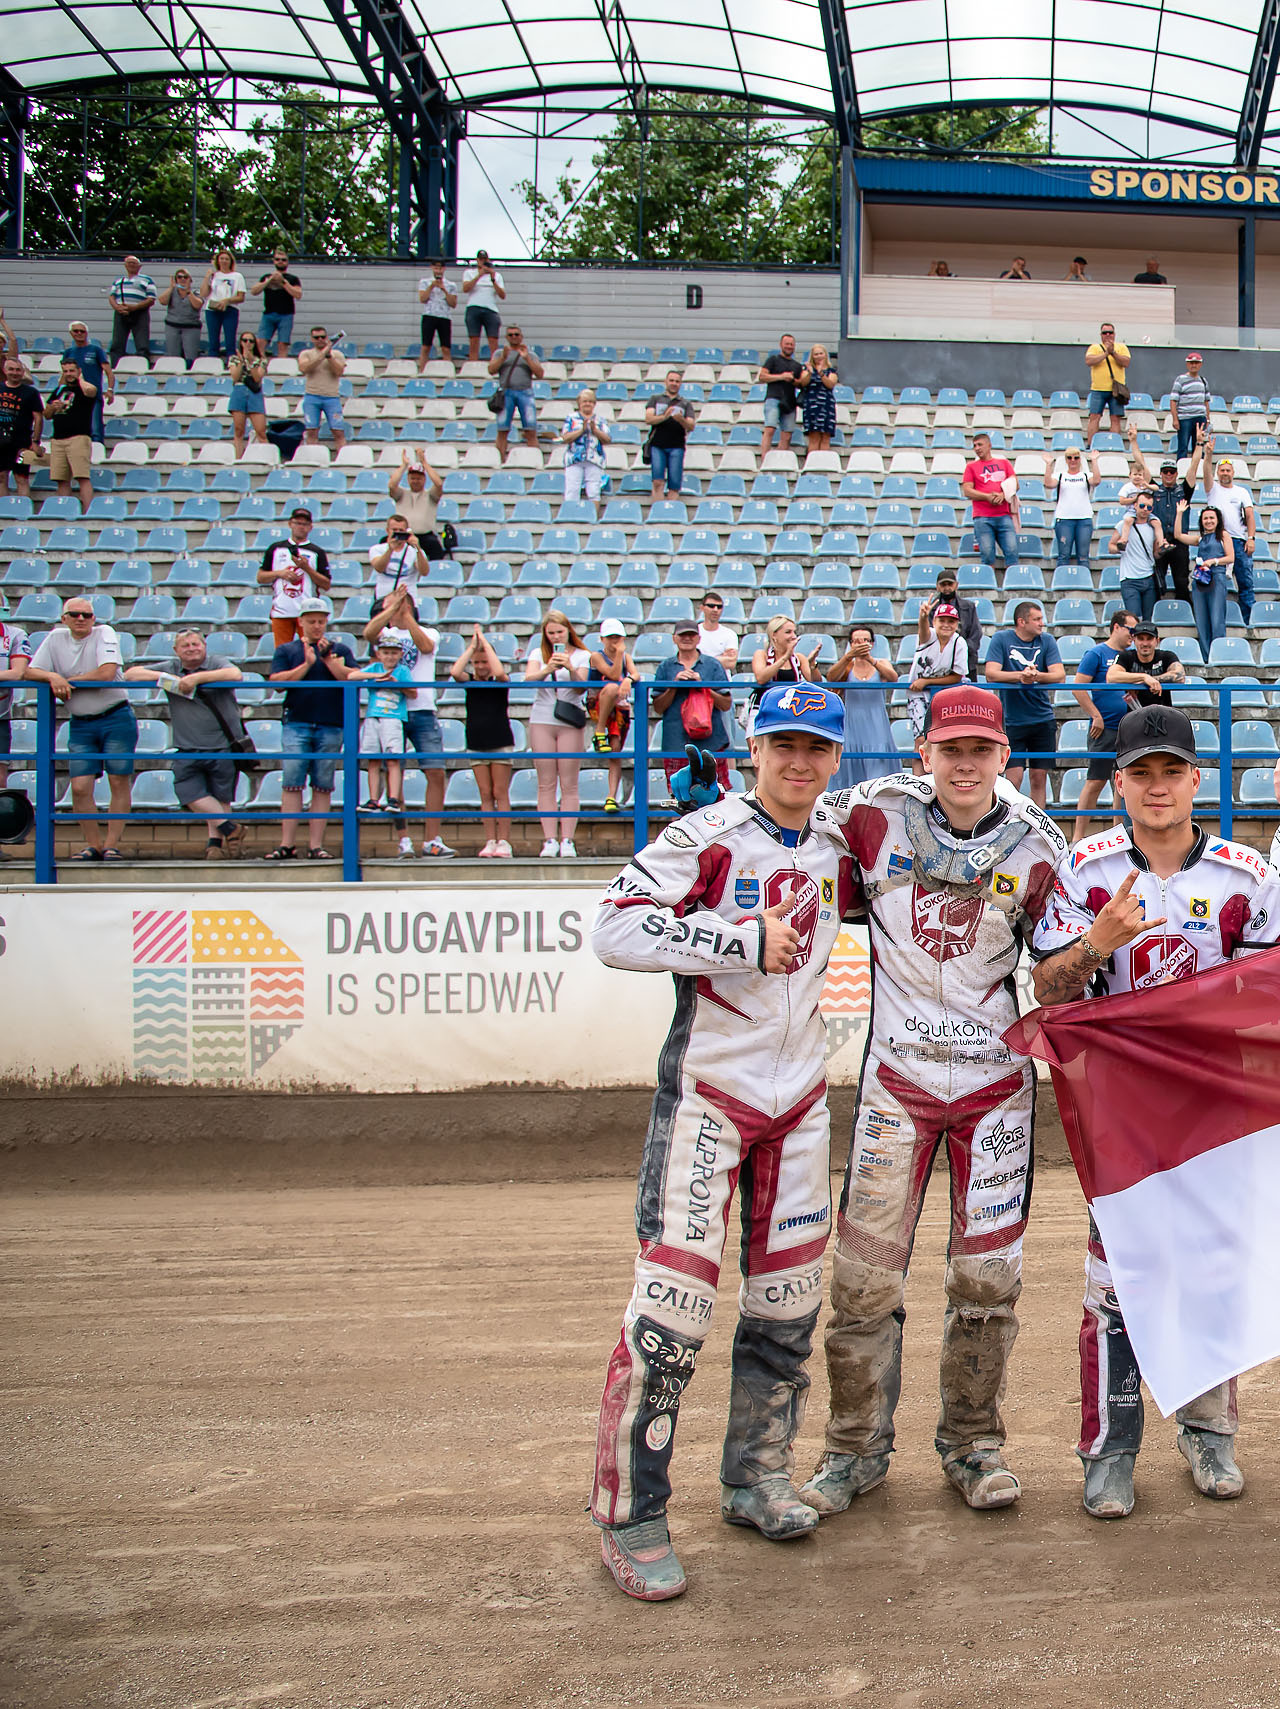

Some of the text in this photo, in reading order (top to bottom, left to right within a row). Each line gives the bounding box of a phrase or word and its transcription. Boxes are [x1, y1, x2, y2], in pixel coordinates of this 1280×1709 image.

[686, 284, 703, 310] D
[940, 704, 995, 721] RUNNING
[1087, 834, 1126, 854] SELS
[1234, 850, 1267, 878] SELS
[327, 910, 584, 955] DAUGAVPILS
[641, 913, 747, 961] SOFIA
[327, 970, 565, 1016] IS SPEEDWAY
[685, 1111, 723, 1243] ALPROMA
[776, 1203, 830, 1232] ewinner
